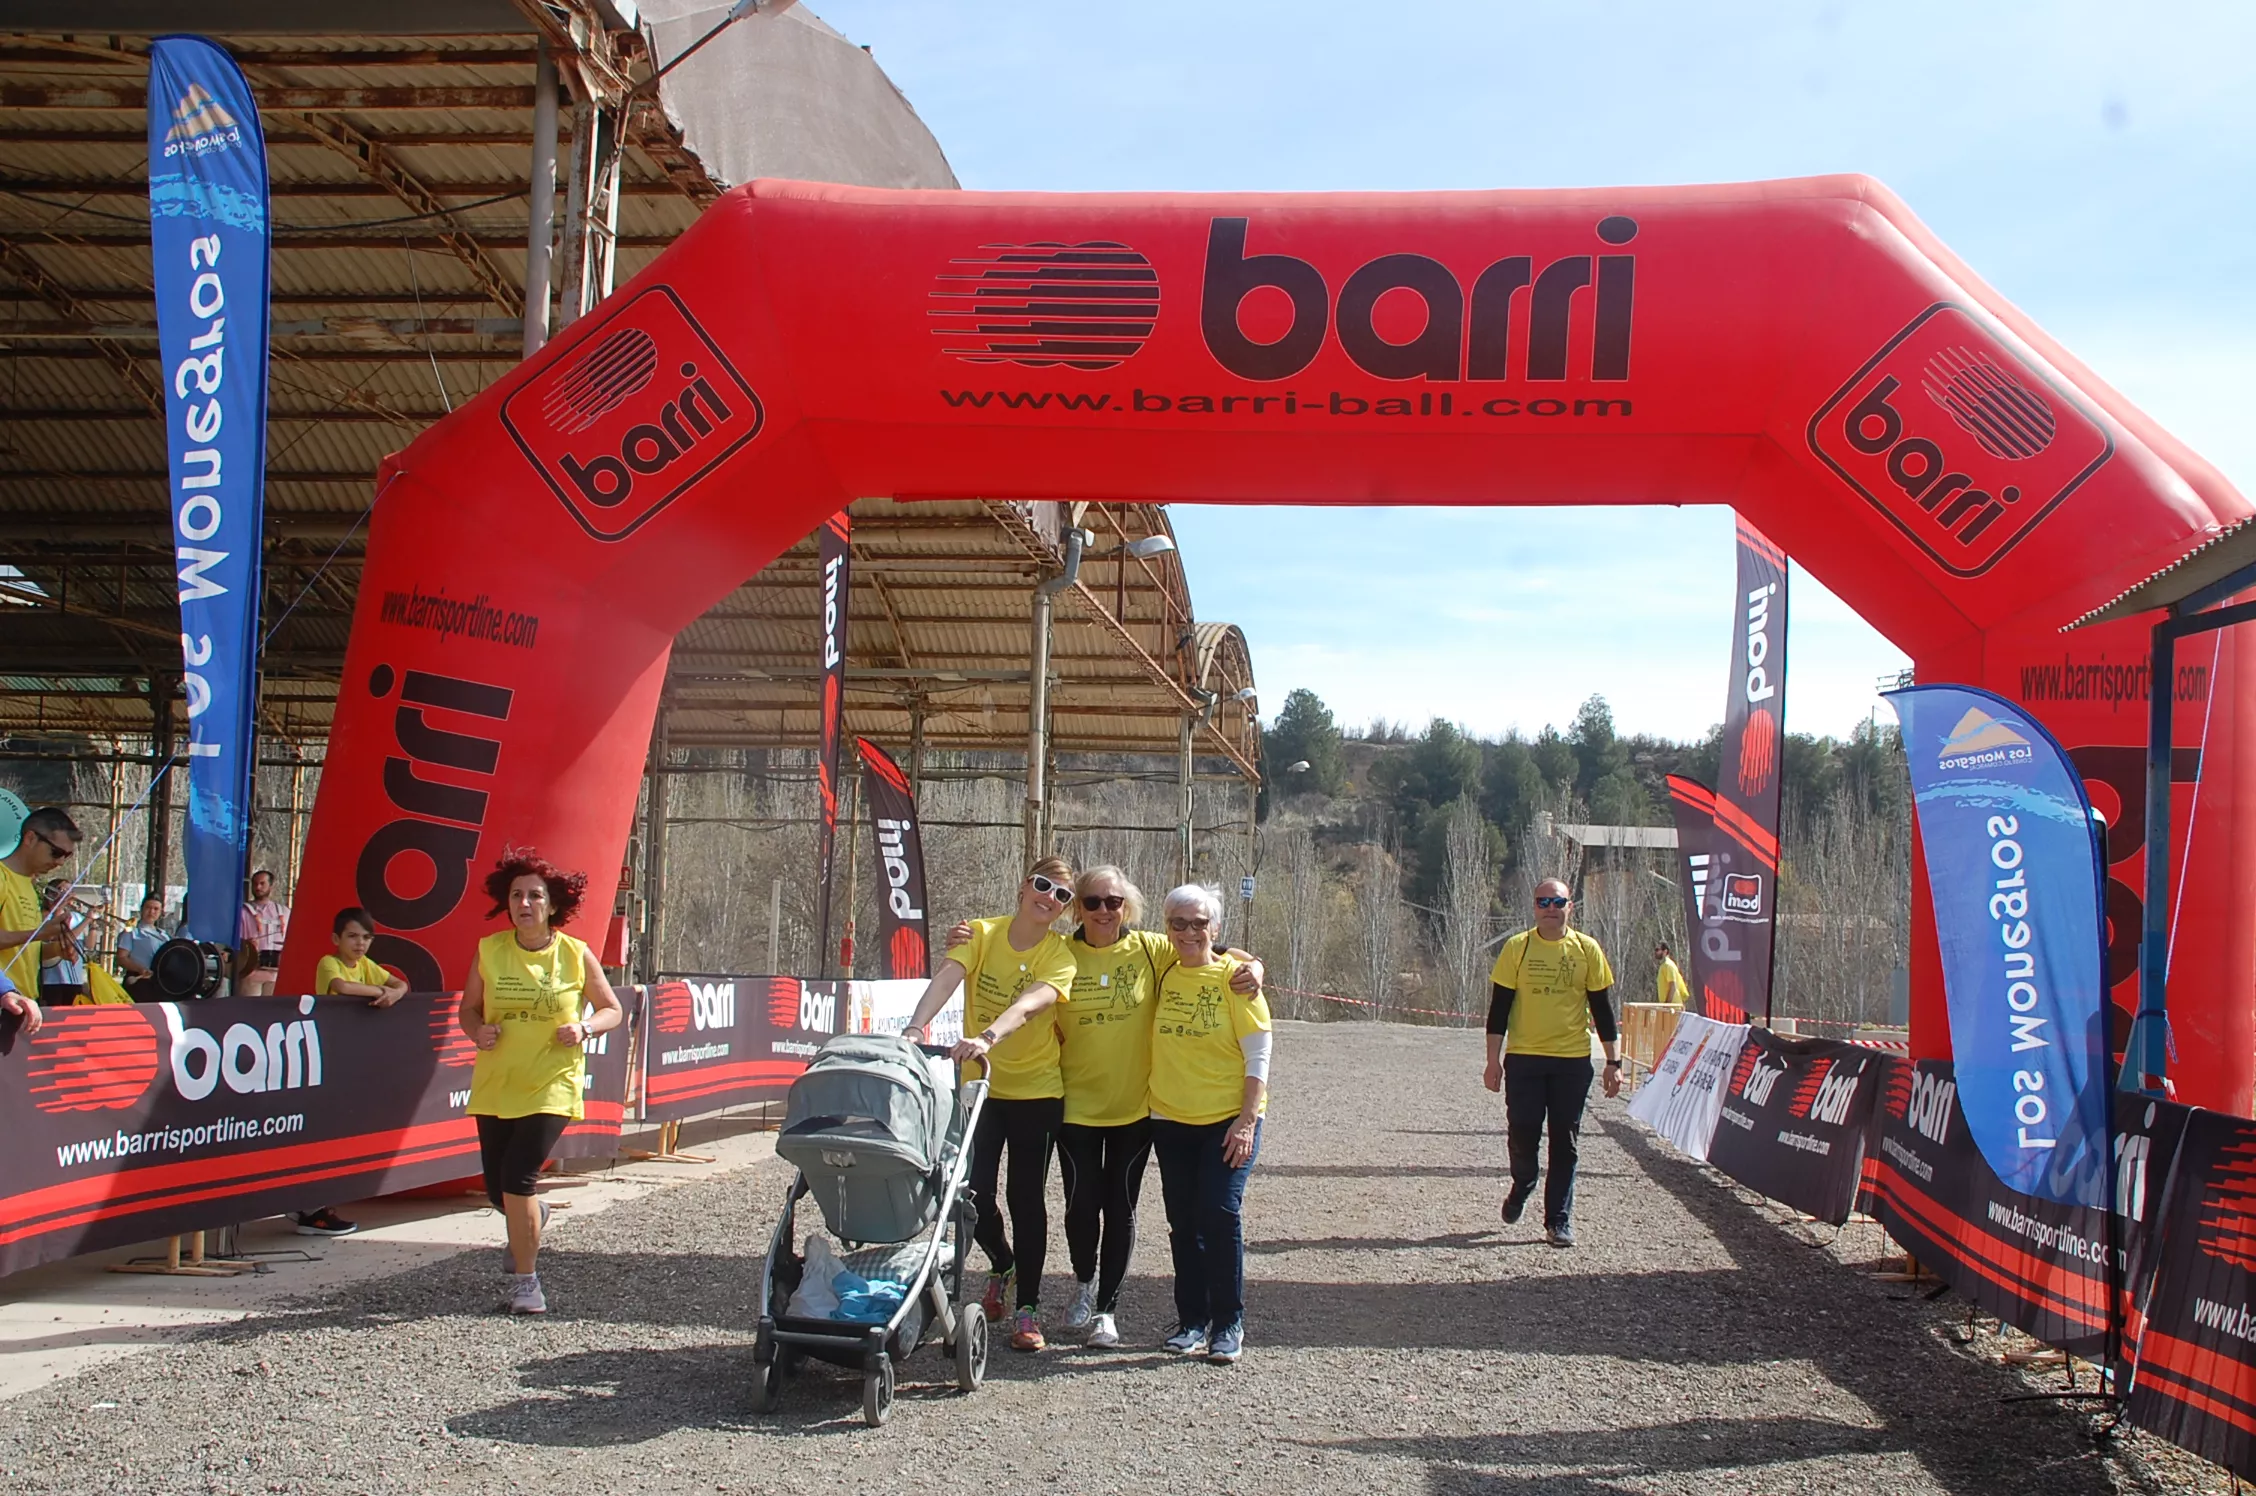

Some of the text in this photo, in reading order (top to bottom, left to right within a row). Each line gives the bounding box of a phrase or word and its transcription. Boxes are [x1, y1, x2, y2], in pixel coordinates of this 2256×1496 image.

[1199, 214, 1639, 383] barri
[556, 360, 734, 509] barri
[940, 388, 1633, 417] www.barri-ball.com
[1843, 373, 2021, 547] barri
[2020, 652, 2207, 713] www.barrisport.com
[681, 977, 735, 1032] barri
[800, 980, 837, 1035] barri
[158, 994, 322, 1101] barri
[1810, 1059, 1867, 1126] barri
[57, 1112, 305, 1168] www.barrisportline.com
